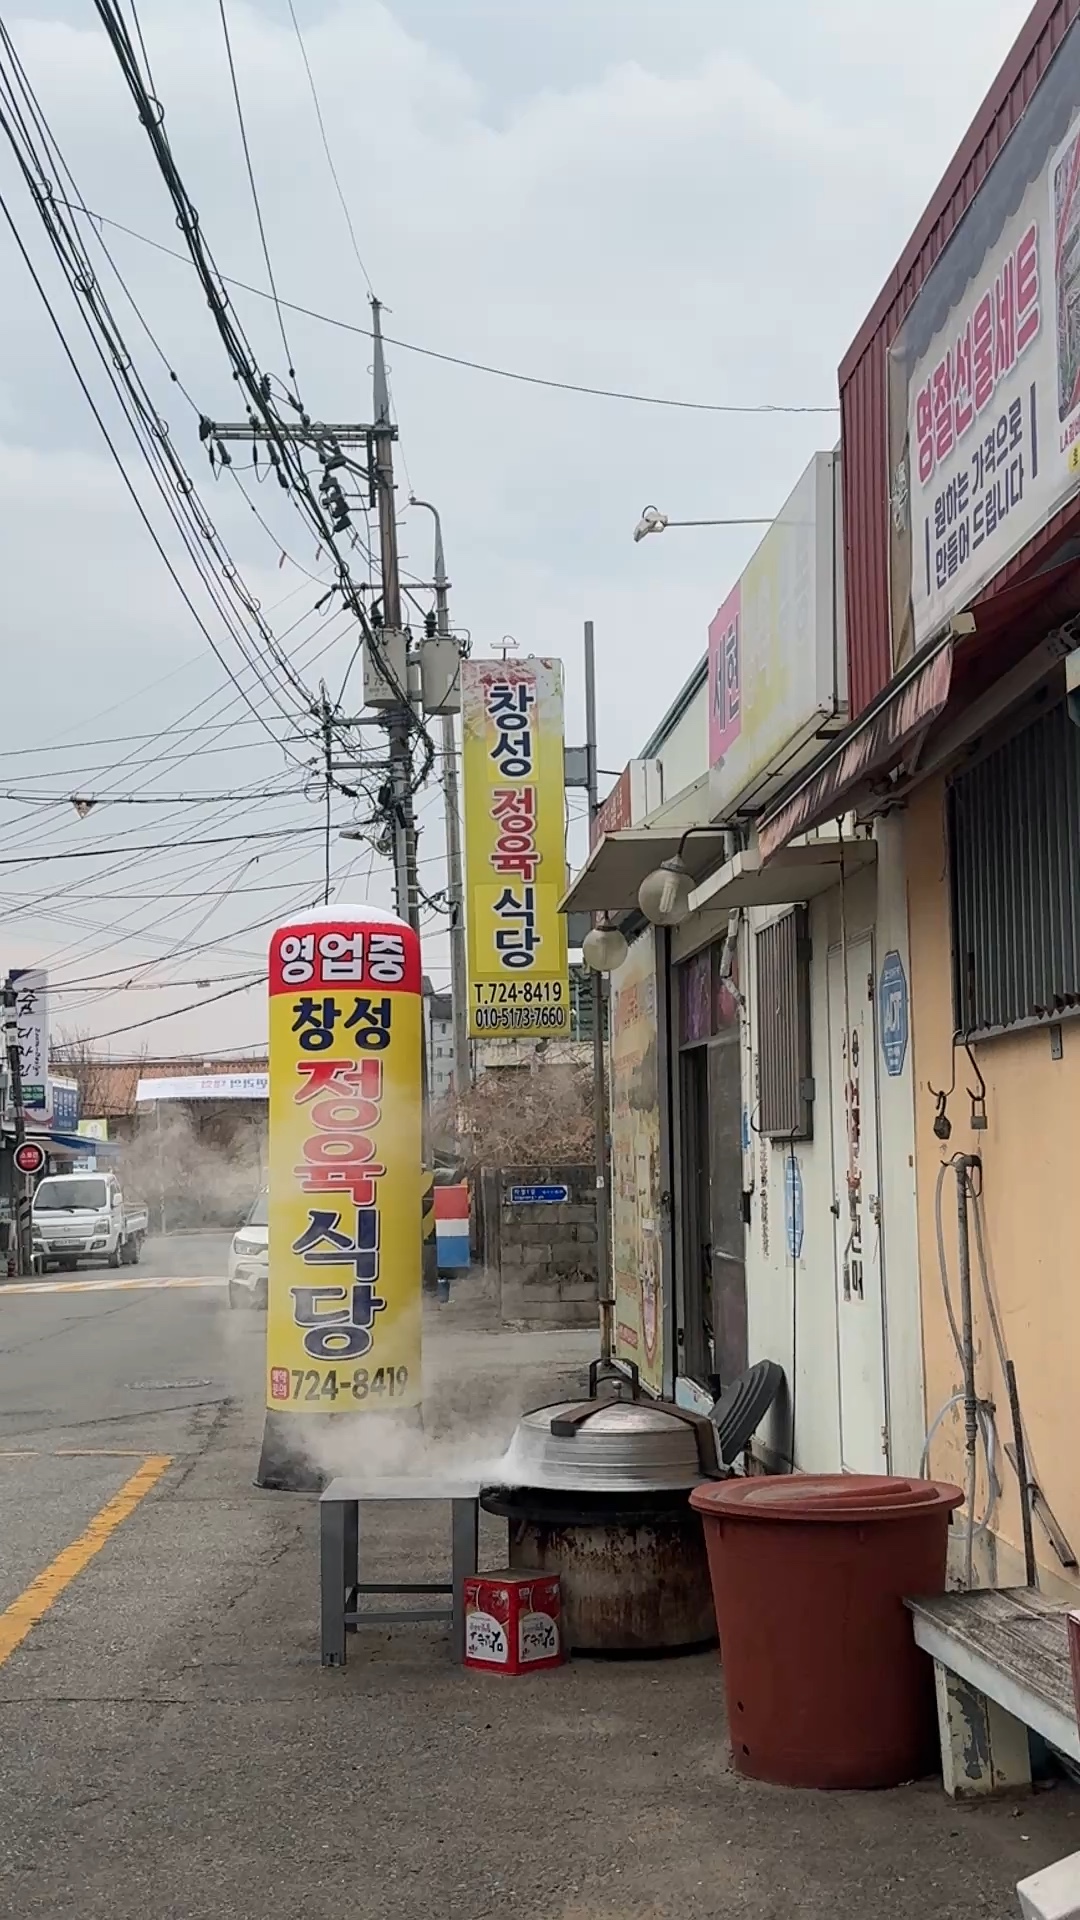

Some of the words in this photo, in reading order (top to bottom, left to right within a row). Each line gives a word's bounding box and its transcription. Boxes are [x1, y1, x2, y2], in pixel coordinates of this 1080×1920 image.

[916, 220, 1040, 485] 명절선물세트
[934, 471, 969, 540] 원하는
[971, 396, 1023, 496] 가격으로
[935, 515, 970, 590] 만들어
[972, 452, 1024, 551] 드립니다
[487, 682, 535, 778] 창성
[279, 932, 406, 985] 영업중
[292, 997, 392, 1051] 창성
[475, 1006, 565, 1029] 010-5173-7660
[291, 1365, 409, 1401] 724-8419
